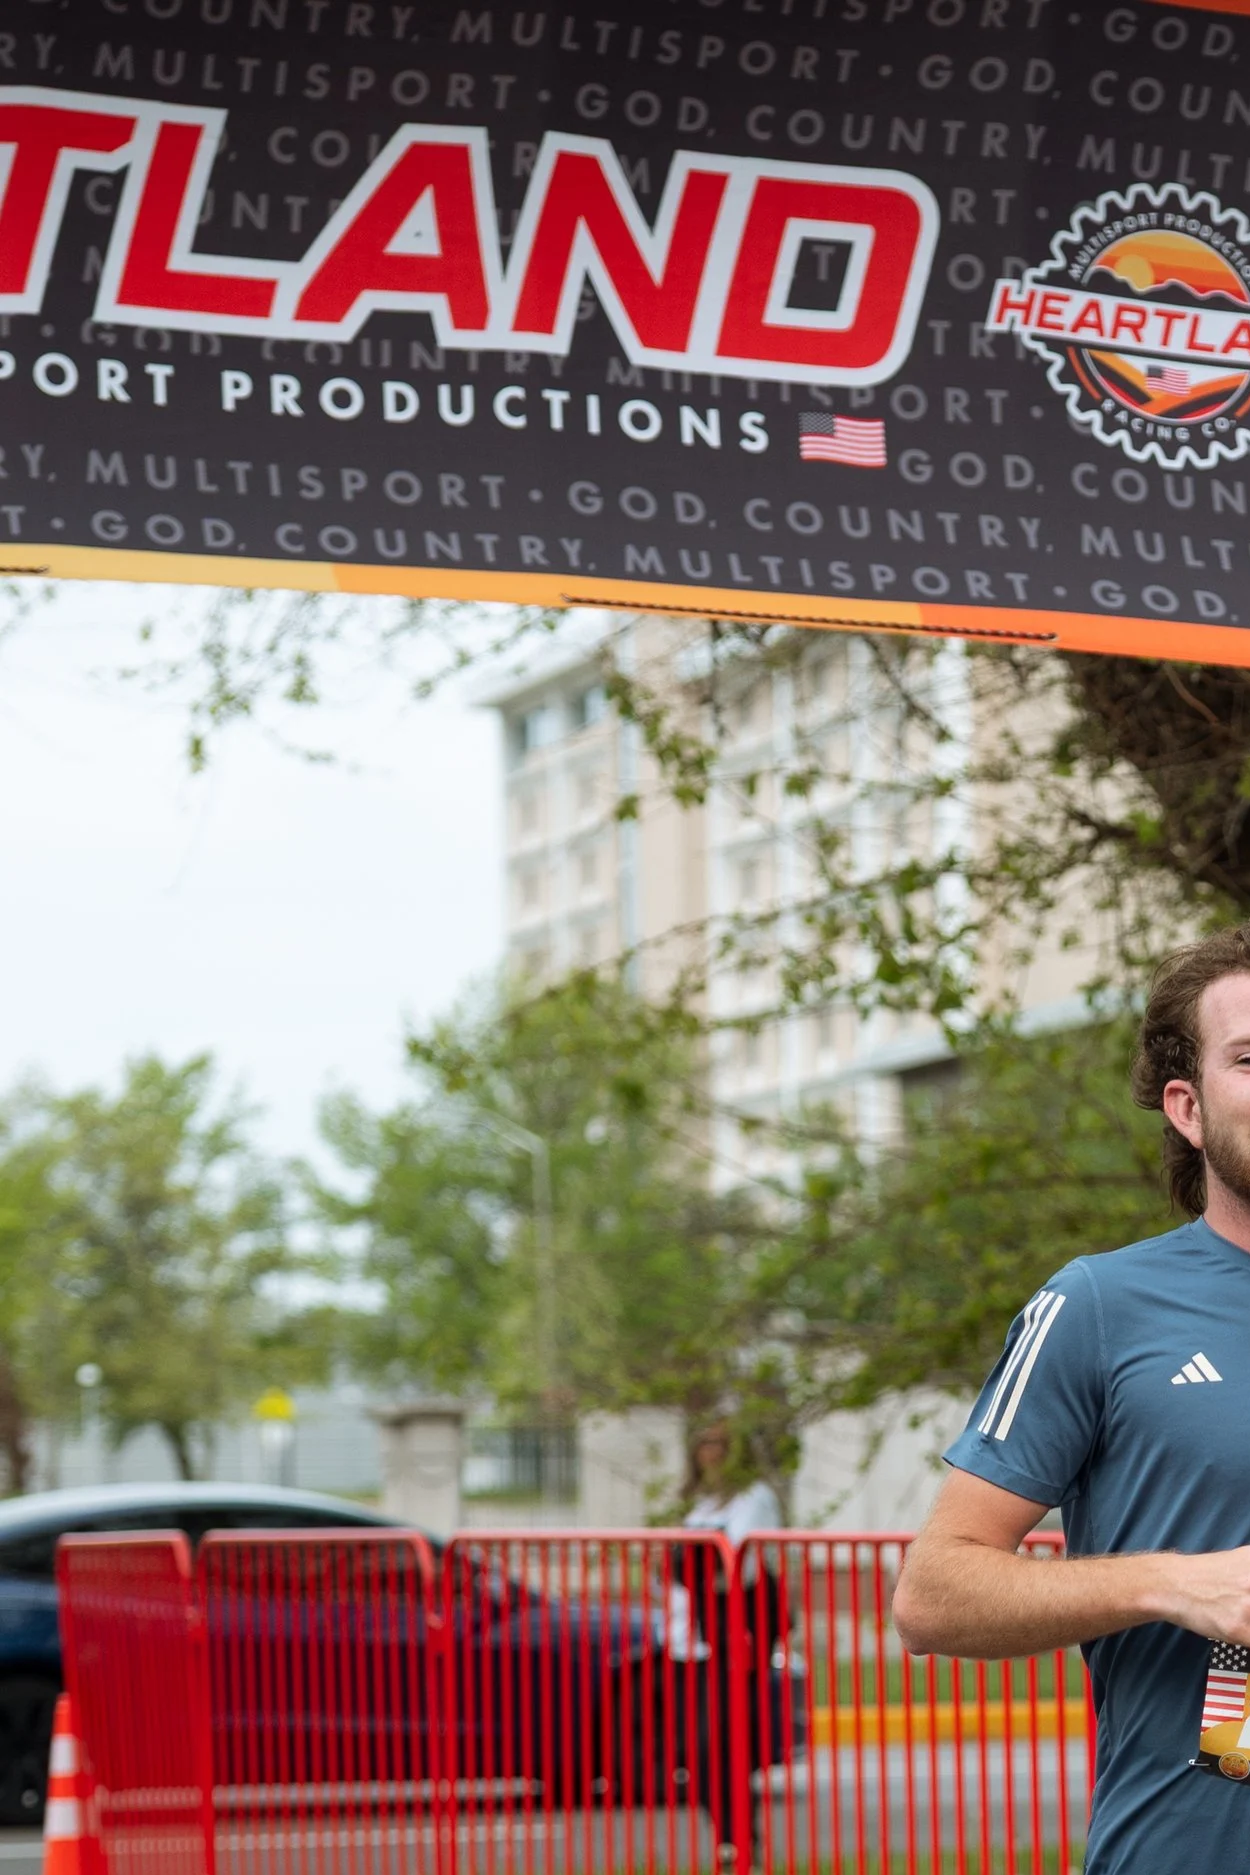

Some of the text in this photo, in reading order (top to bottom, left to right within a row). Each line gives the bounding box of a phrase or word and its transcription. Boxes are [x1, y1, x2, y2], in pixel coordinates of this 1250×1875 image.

[92, 41, 517, 110] MULTISPORT
[449, 10, 861, 84] MULTISPORT
[1067, 212, 1159, 281] MULTISPORT
[220, 369, 769, 455] PRODUCTIONS
[1101, 398, 1190, 443] RACING
[85, 448, 506, 510] MULTISPORT
[622, 543, 1030, 601] MULTISPORT
